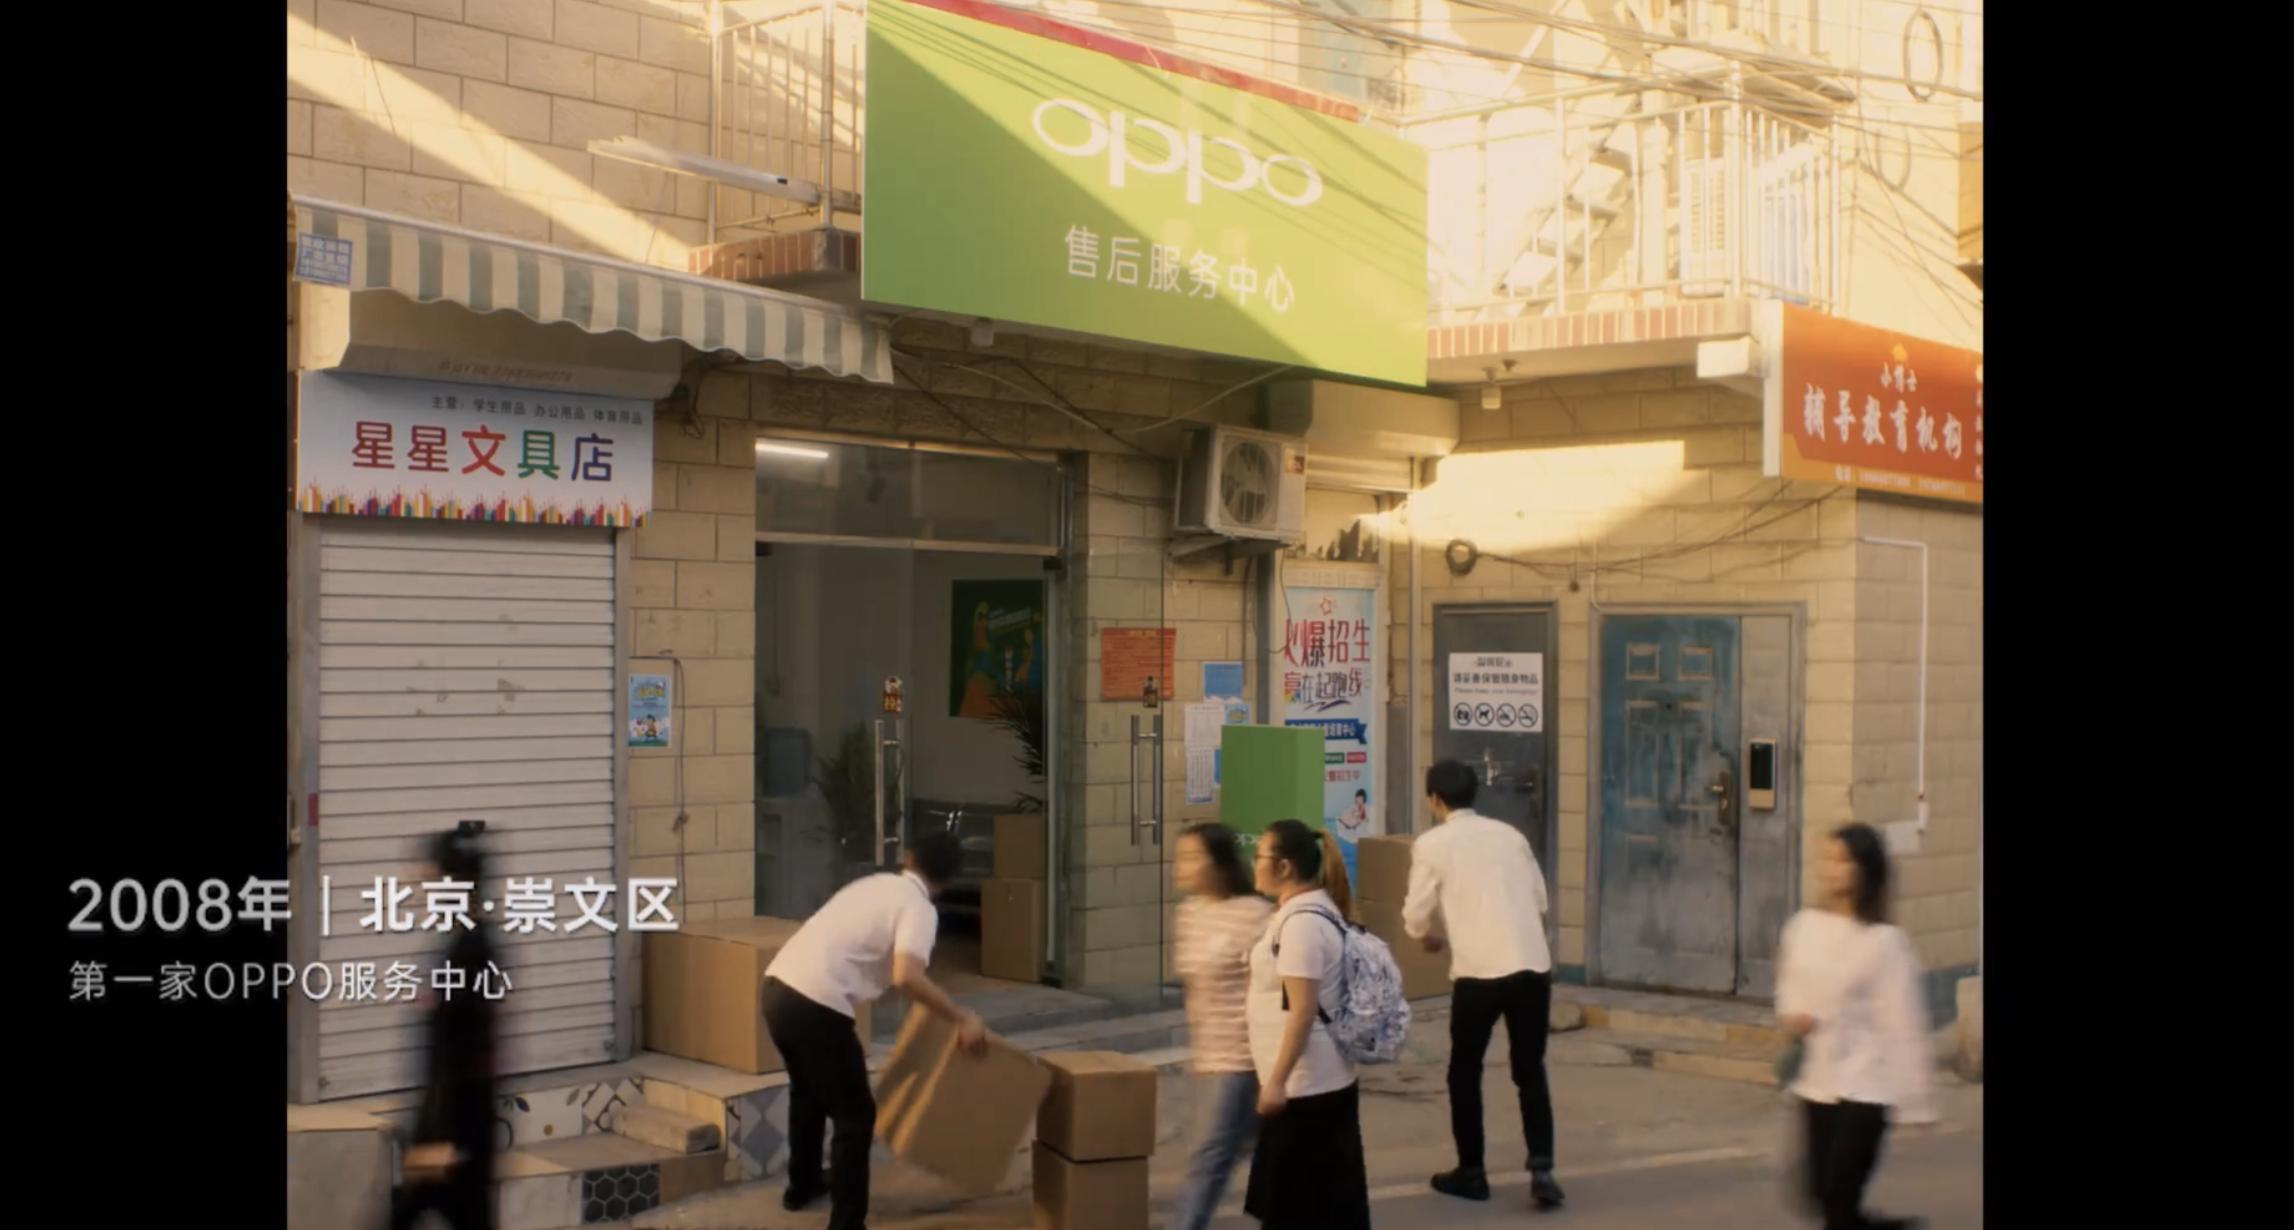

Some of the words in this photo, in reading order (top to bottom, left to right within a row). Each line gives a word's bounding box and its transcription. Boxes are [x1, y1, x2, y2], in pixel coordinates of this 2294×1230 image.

[1065, 223, 1294, 313] 售后服务中心
[473, 398, 526, 415] 学生用品
[534, 404, 585, 420] 办公用品
[593, 408, 643, 425] 体育用品
[1804, 382, 1962, 460] 辅导教育机构
[352, 421, 614, 481] 星星文具店
[1284, 617, 1371, 668] 火爆招生
